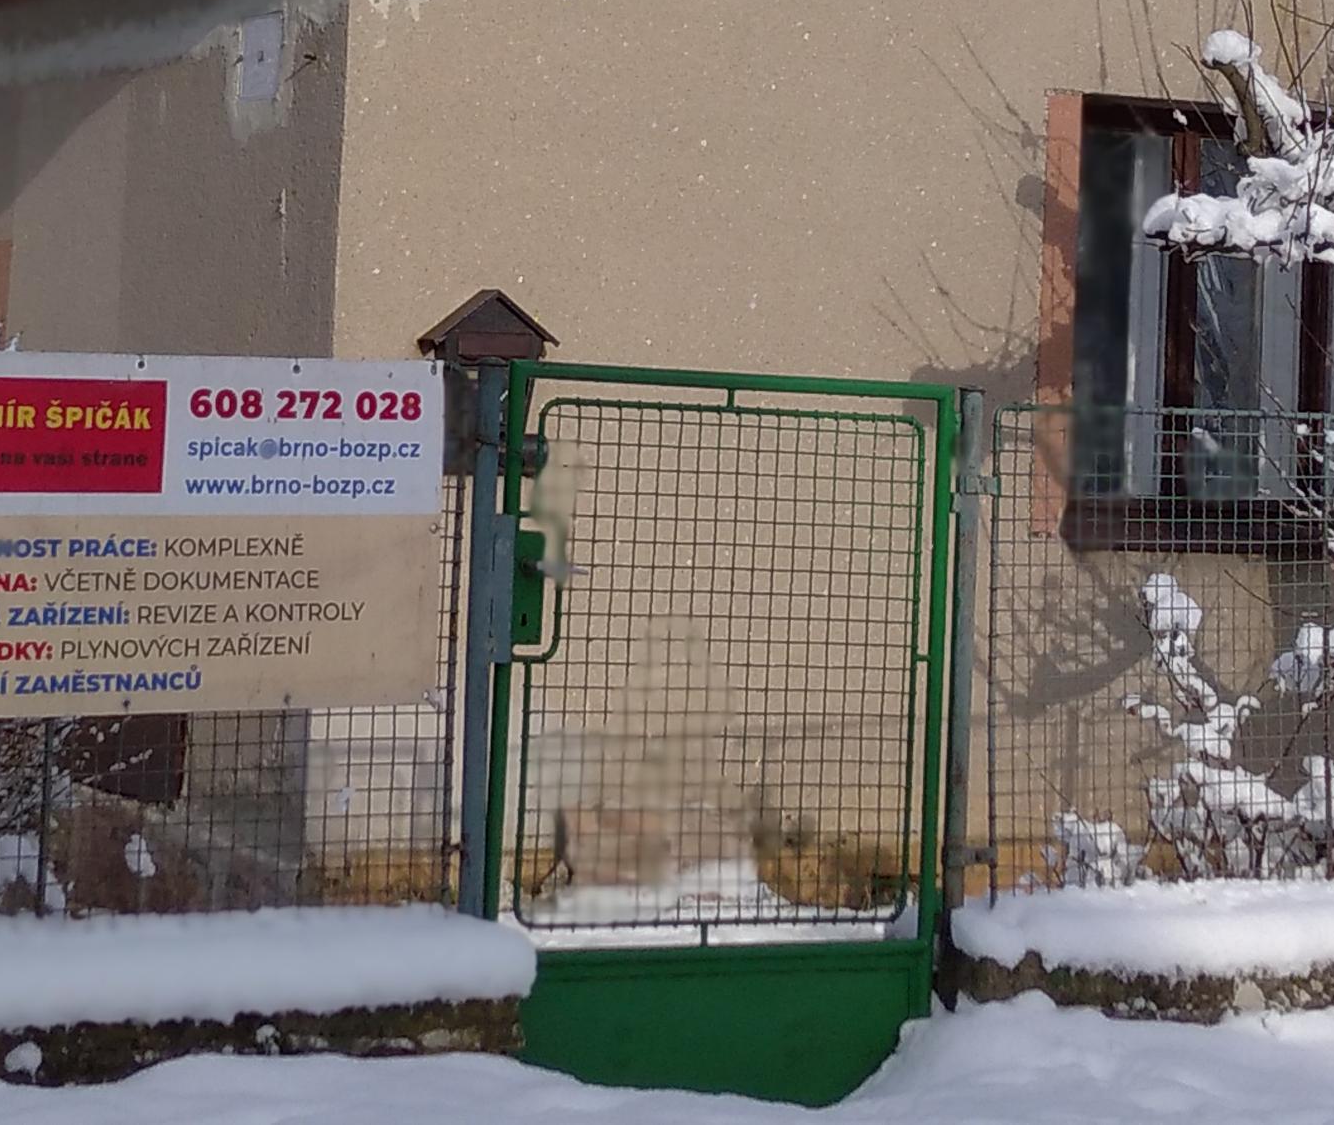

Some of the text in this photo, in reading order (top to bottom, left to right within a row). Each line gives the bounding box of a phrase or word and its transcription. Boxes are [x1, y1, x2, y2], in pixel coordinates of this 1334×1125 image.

[46, 399, 152, 430] ŠPIČÁK
[190, 389, 422, 420] 608 272 028
[185, 475, 395, 498] www.brno-bozp.cz
[68, 535, 157, 557] PRÁCE:
[165, 534, 304, 557] KOMPLEXNĚ
[44, 568, 136, 592] VČETNĚ
[144, 570, 319, 591] DOKUMENTACE
[7, 601, 130, 626] ZAŘÍZENÍ:
[138, 605, 217, 624] REVIZE
[223, 605, 239, 623] A
[246, 602, 365, 622] KONTROLY
[61, 635, 200, 659] PLYNOVÝCH
[207, 632, 312, 656] ZAŘÍZENÍ
[15, 665, 202, 694] ZAMĚSTNANCŮ
